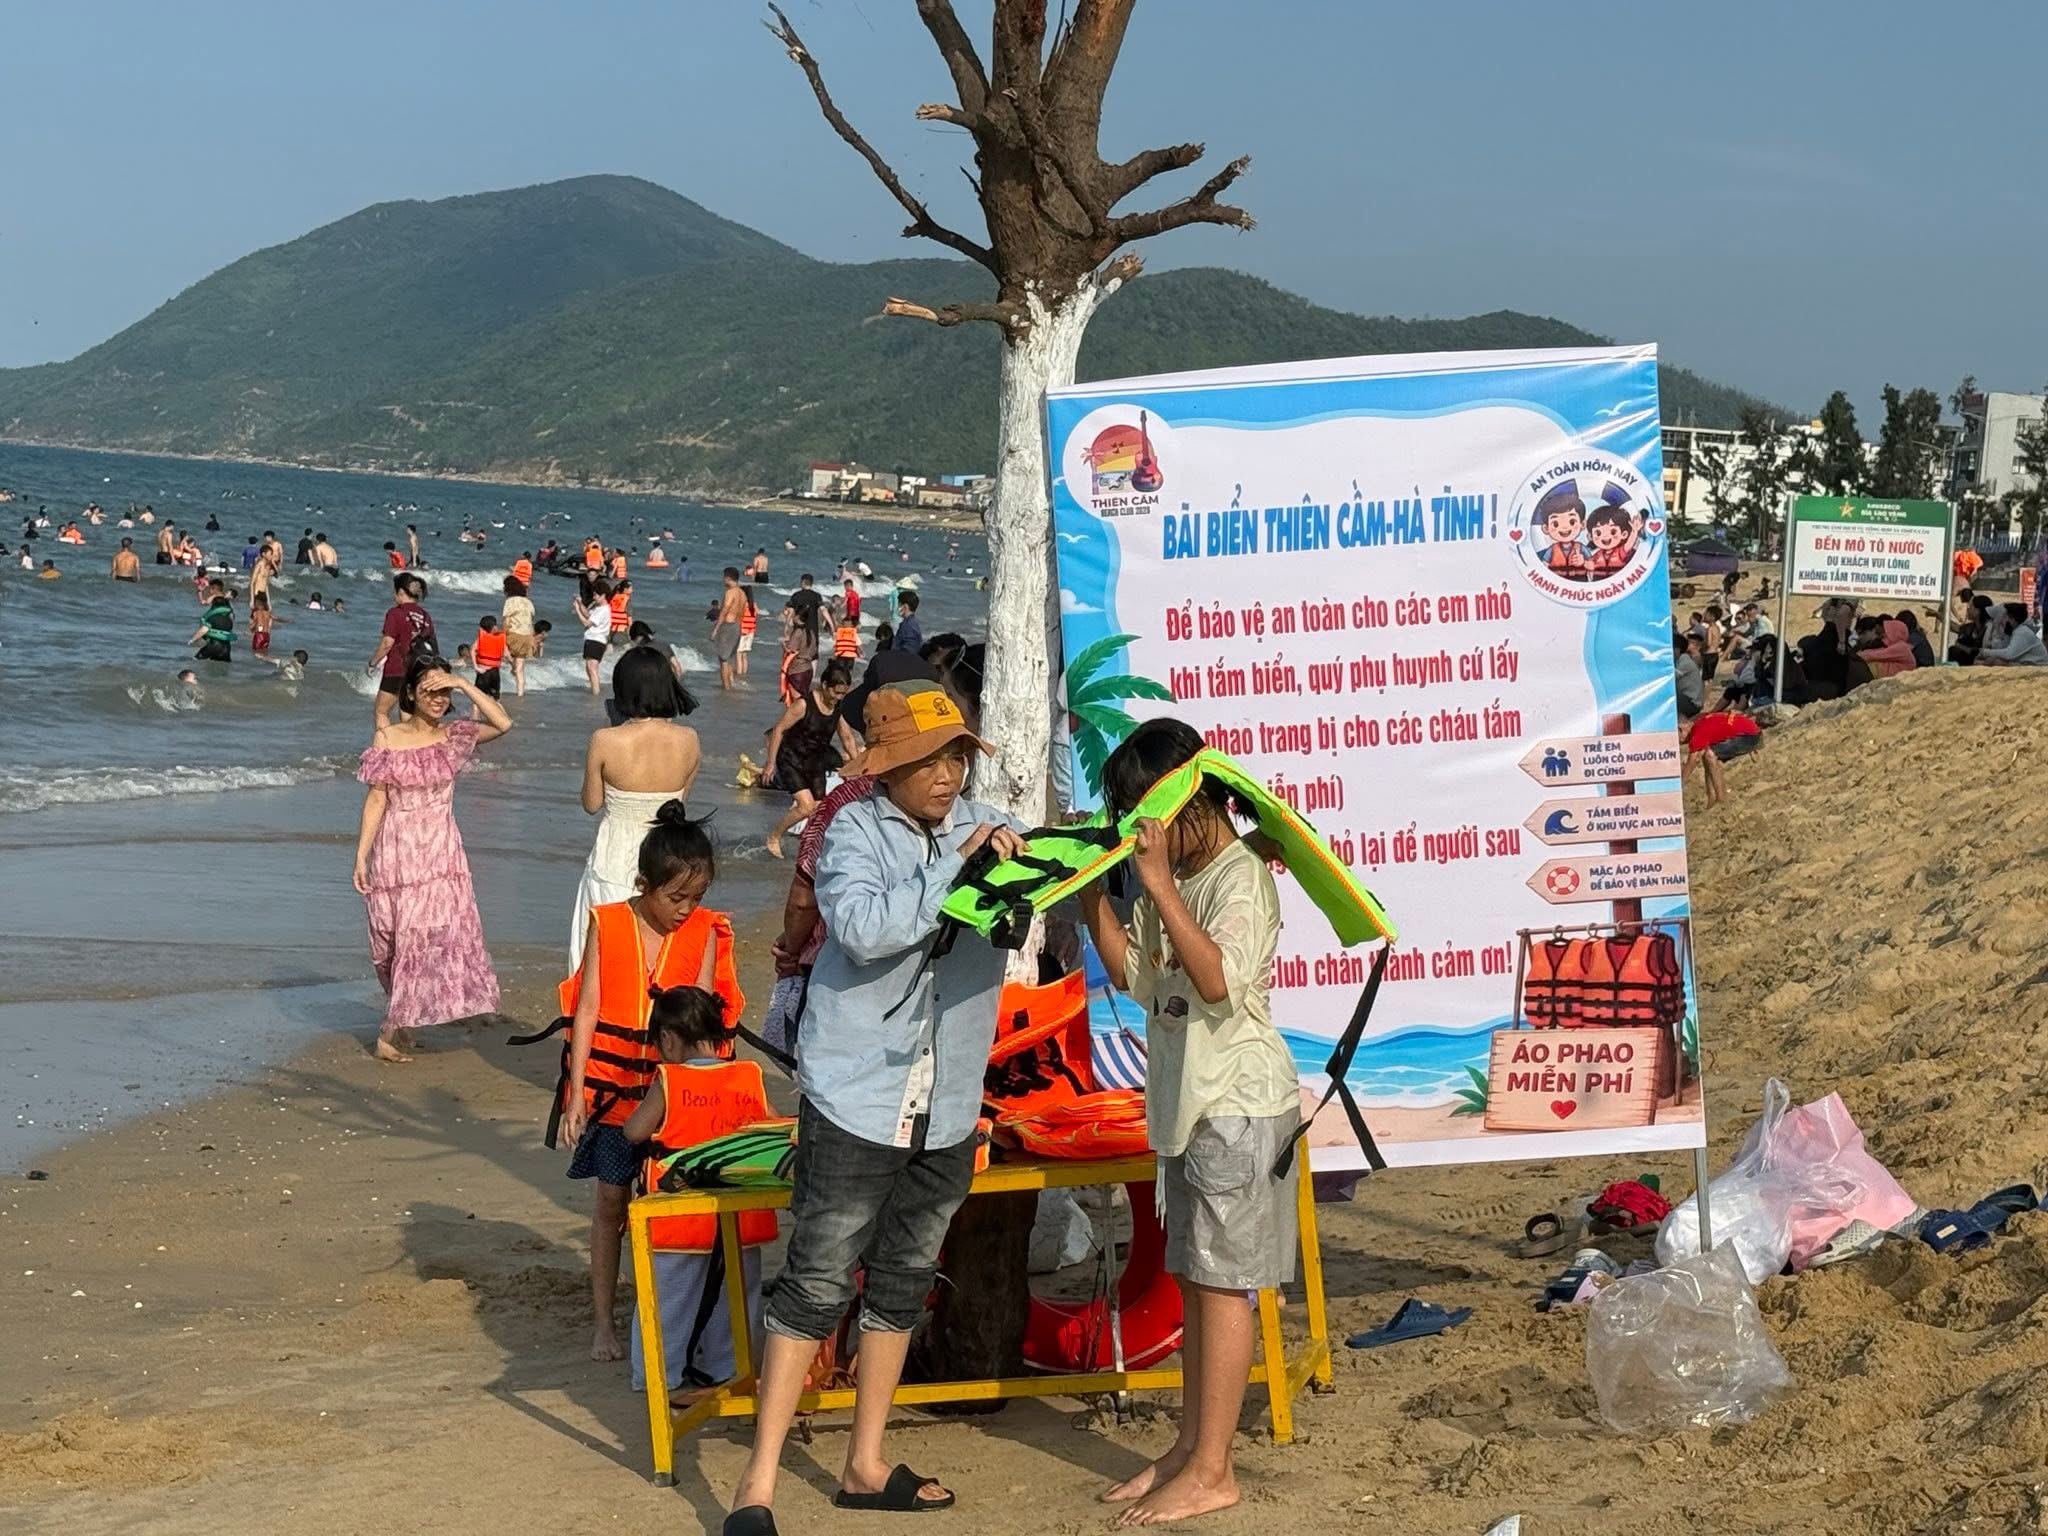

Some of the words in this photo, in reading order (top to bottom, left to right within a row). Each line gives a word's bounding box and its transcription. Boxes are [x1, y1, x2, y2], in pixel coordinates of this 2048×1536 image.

[1530, 475, 1547, 493] AN
[1547, 460, 1580, 480] TOÀN
[1583, 459, 1612, 474] HÔM
[1614, 468, 1638, 486] NAY
[1163, 503, 1200, 560] BÃI
[1207, 484, 1258, 557] BIỂN
[1265, 494, 1329, 552] THIÊN
[1337, 480, 1425, 548] CẦM-HÀ
[1432, 486, 1484, 542] TĨNH
[1815, 534, 1840, 550] BẾN
[1827, 556, 1838, 566] DU
[1841, 555, 1869, 568] KHÁCH
[1872, 558, 1885, 568] VUI
[1528, 569, 1560, 595] HẠNH
[1560, 587, 1594, 601] PHÚC
[1596, 582, 1626, 600] NGÀY
[1627, 564, 1647, 585] MAI
[1850, 572, 1878, 583] TRONG
[1881, 574, 1898, 585] KHU
[1166, 599, 1192, 641] Để
[1199, 601, 1235, 639] bảo
[1241, 602, 1264, 643] vệ
[1272, 607, 1295, 634] an
[1301, 597, 1345, 632] toàn
[1352, 596, 1388, 629] cho
[1396, 592, 1431, 626] các
[1438, 595, 1468, 623] em
[1475, 582, 1511, 621] nhỏ
[1170, 665, 1201, 700] khi
[1207, 656, 1246, 698] tắm
[1252, 652, 1302, 696] biển,
[1309, 656, 1343, 695] quý
[1350, 655, 1386, 694] phụ
[1393, 650, 1452, 688] huynh
[1460, 647, 1483, 681] cứ
[1490, 639, 1518, 682] lấy
[1259, 722, 1312, 755] trang
[1318, 716, 1337, 756] bị
[1344, 715, 1379, 748] cho
[1387, 711, 1422, 745] các
[1430, 707, 1478, 742] cháu
[1483, 698, 1521, 739] tắm
[1583, 755, 1609, 766] LUÔN
[1626, 751, 1657, 762] NGƯỜI
[1604, 742, 1621, 751] EM
[1597, 766, 1626, 777] CÙNG
[1305, 774, 1343, 814] phí)
[1596, 821, 1617, 831] KHU
[1618, 820, 1639, 833] VỰC
[1640, 819, 1654, 828] AN
[1656, 816, 1682, 827] TOÀN
[1361, 831, 1386, 872] lại
[1393, 821, 1417, 863] để
[1424, 825, 1478, 864] người
[1486, 829, 1520, 857] sau
[1615, 862, 1630, 875] ÁO
[1633, 863, 1662, 873] PHAO
[1315, 950, 1363, 986] chân
[1432, 940, 1474, 978] cảm
[1481, 941, 1512, 975] ơn!
[1511, 1039, 1549, 1064] ÁO
[1557, 1043, 1634, 1064] PHAO
[1506, 1064, 1577, 1093] MIỄN
[1584, 1067, 1634, 1093] PHÍ
